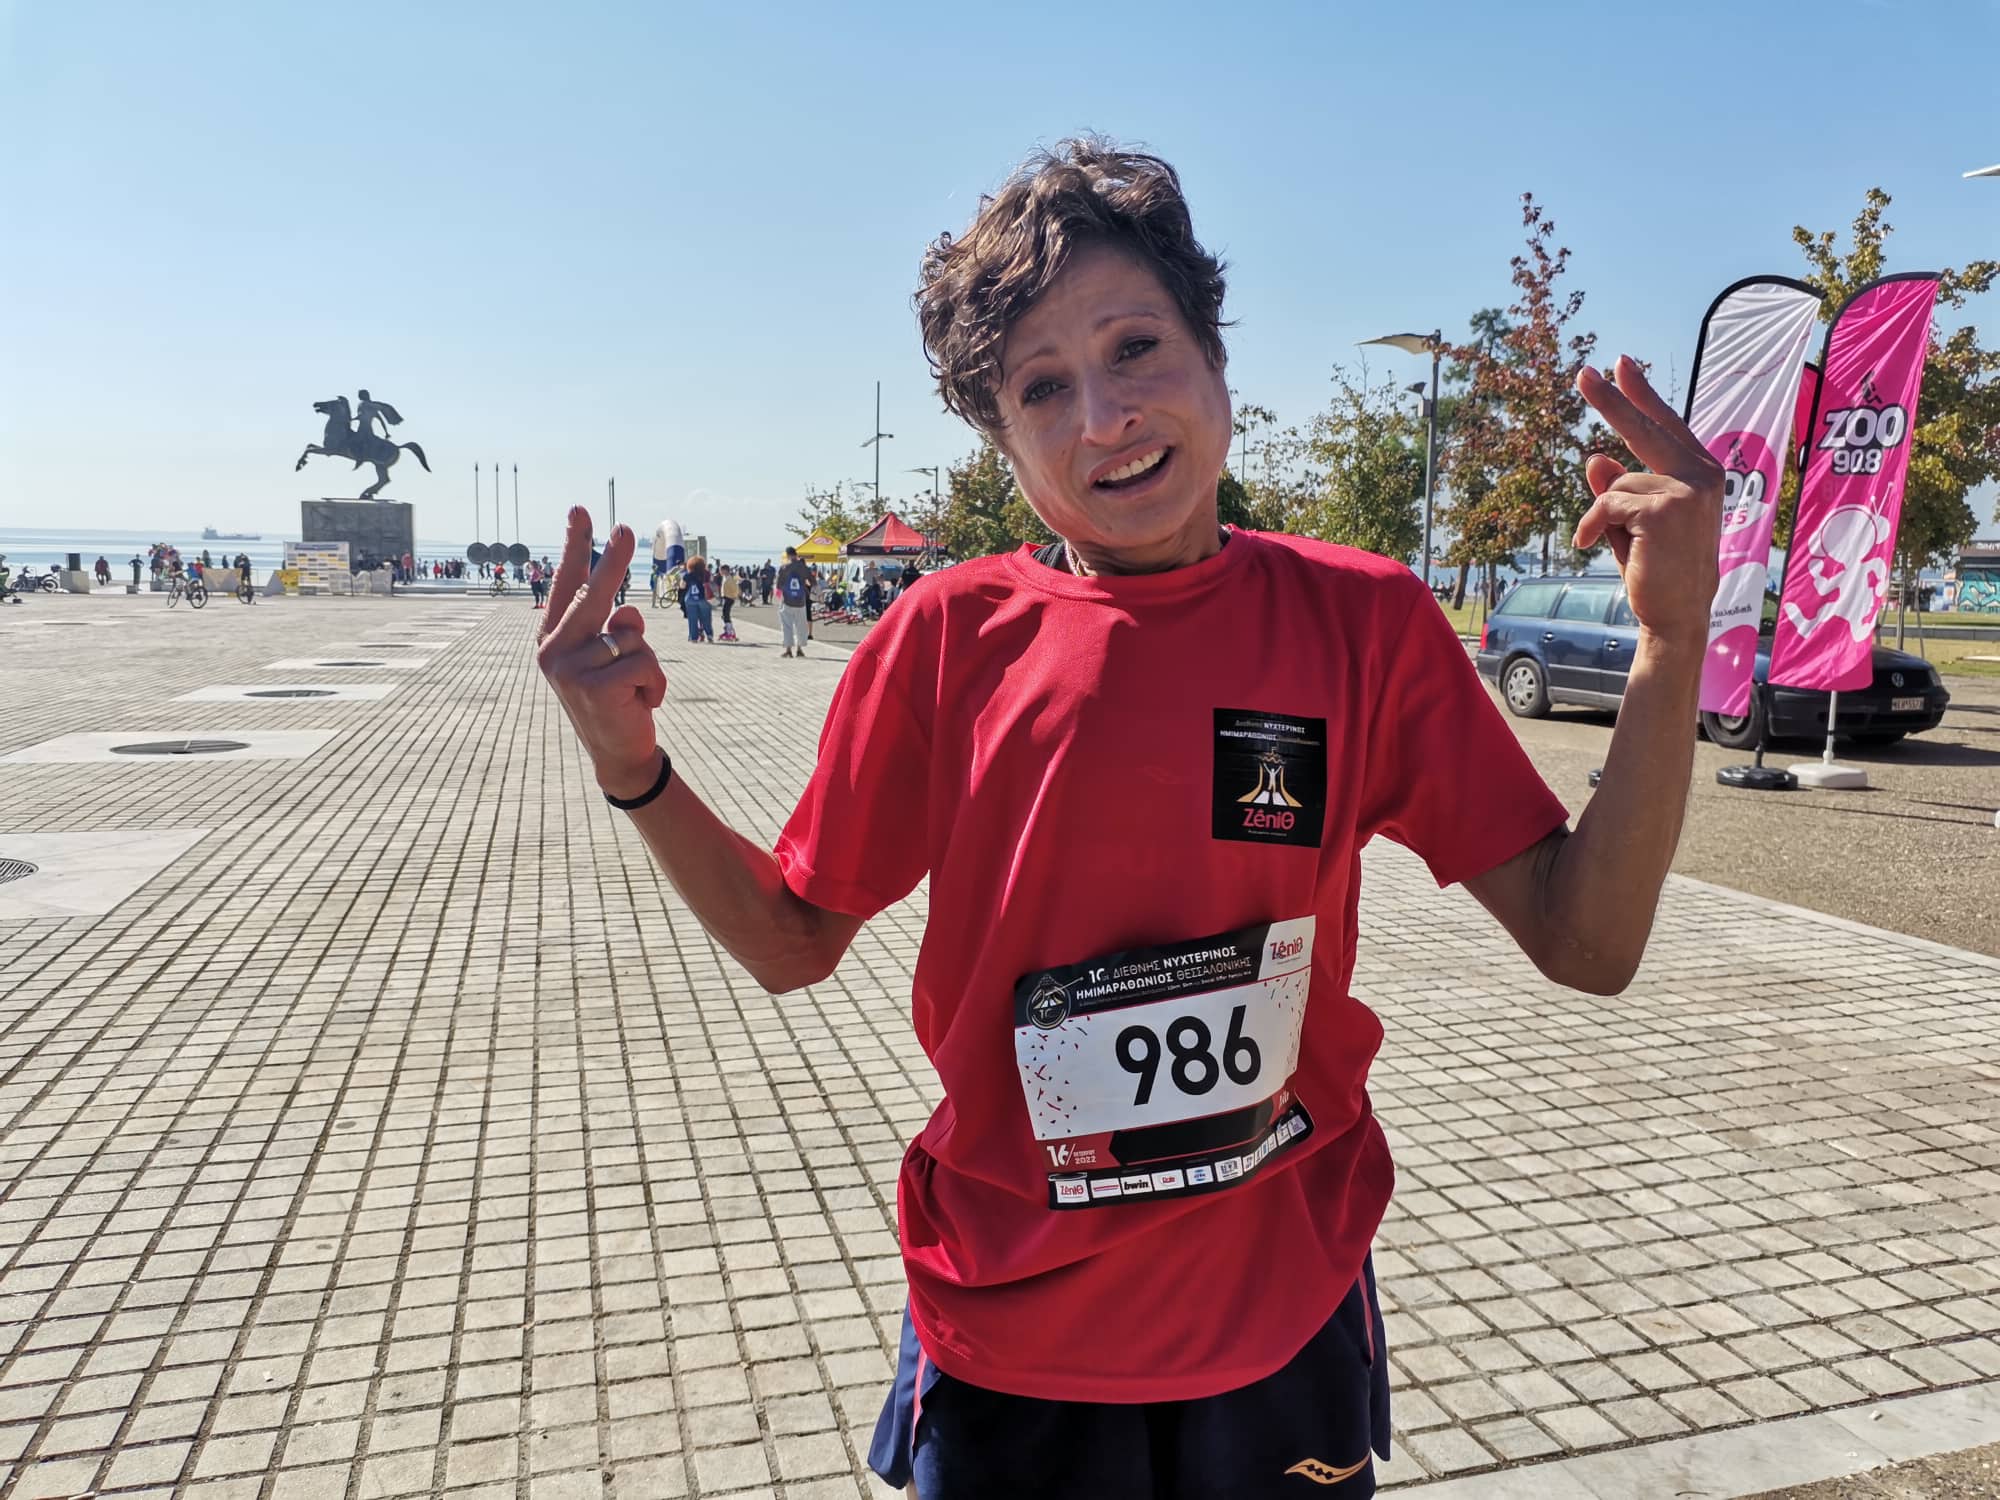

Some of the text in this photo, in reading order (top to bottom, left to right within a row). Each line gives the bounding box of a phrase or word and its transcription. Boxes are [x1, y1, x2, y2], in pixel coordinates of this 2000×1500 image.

[1818, 405, 1906, 449] ZOO
[1833, 449, 1882, 474] 90.8
[1725, 469, 1766, 504] OO
[1076, 972, 1174, 1000] ΗΜΙΜΑΡΑΘΩΝΙΟΣ
[1176, 957, 1252, 981] ΘΕΣΣΑΛΟΝΙΚΗΣ
[1113, 960, 1160, 979] ΔΙΕΘΝΗΣ
[1163, 946, 1237, 968] ΝΥΧΤΕΡΙΝΟΣ
[1115, 1004, 1262, 1106] 986
[1075, 1155, 1096, 1165] 2022
